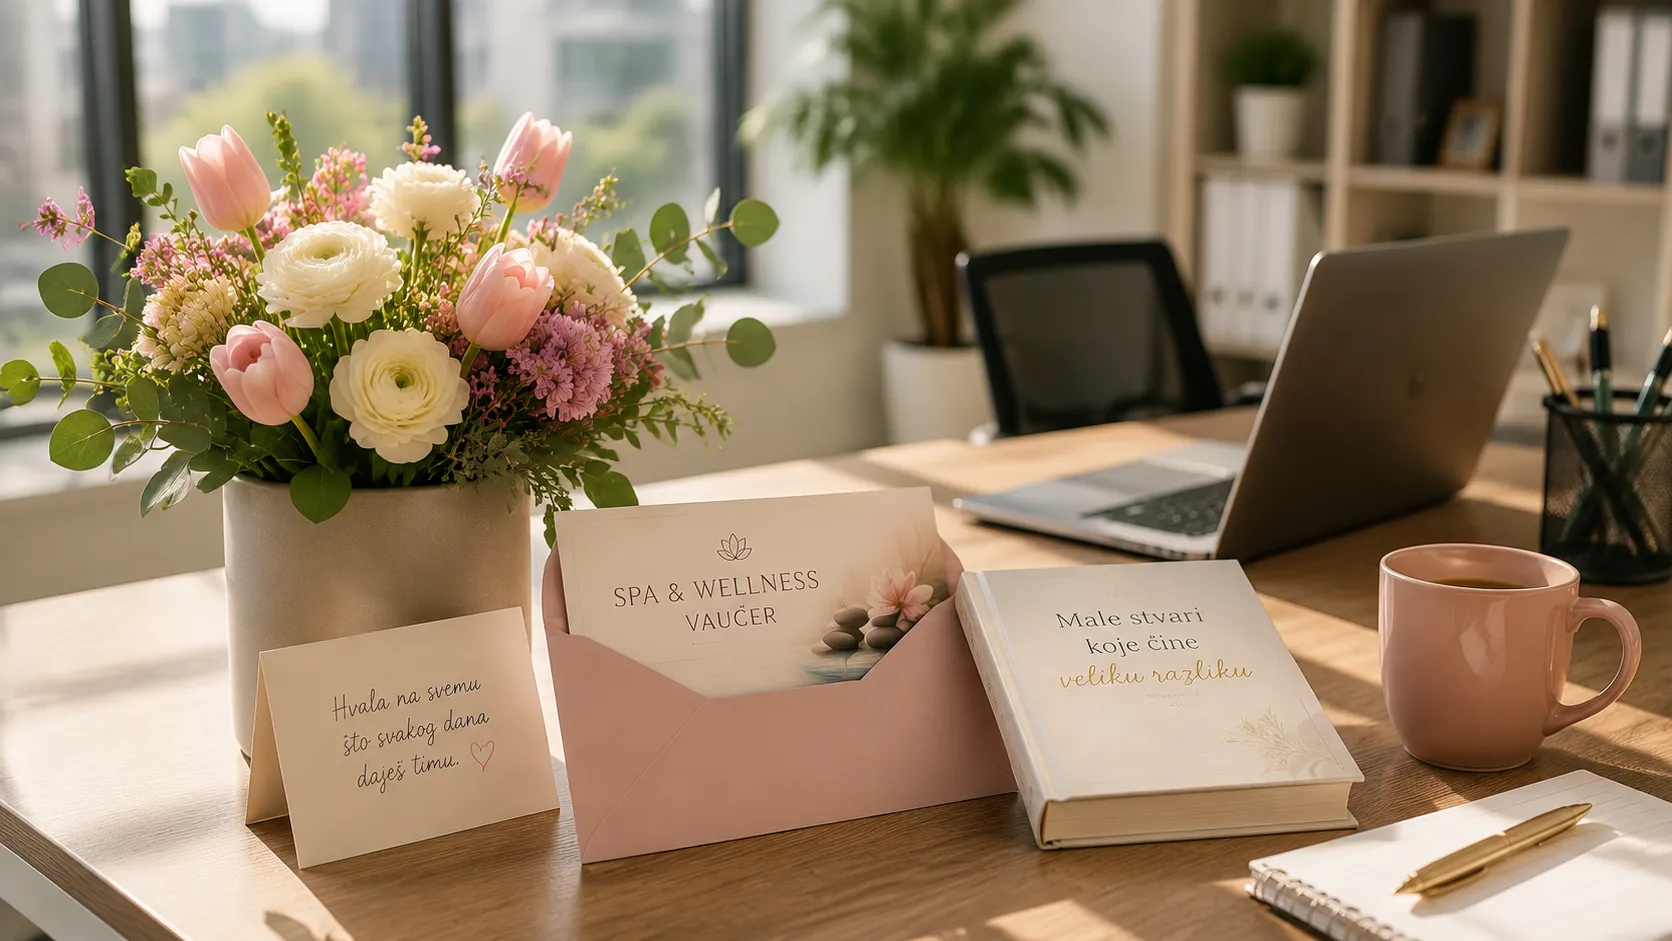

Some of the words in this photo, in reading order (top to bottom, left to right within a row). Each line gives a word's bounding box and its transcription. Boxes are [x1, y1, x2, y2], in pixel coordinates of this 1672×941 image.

[614, 584, 660, 608] SPA
[668, 582, 685, 603] &
[692, 570, 820, 600] WELLNESS
[685, 604, 778, 632] VAUČER
[1055, 610, 1122, 629] Male
[1129, 607, 1205, 626] stvari
[1085, 637, 1140, 658] koje
[1147, 634, 1200, 651] čine
[1060, 663, 1145, 689] veliku
[1152, 658, 1253, 686] razliku
[332, 688, 391, 722] Hvala
[397, 690, 421, 707] na
[427, 679, 482, 702] svemu
[343, 732, 371, 757] što
[377, 718, 438, 748] svakog
[443, 709, 491, 732] dana
[357, 760, 406, 794] daješ
[411, 753, 460, 776] timu.
